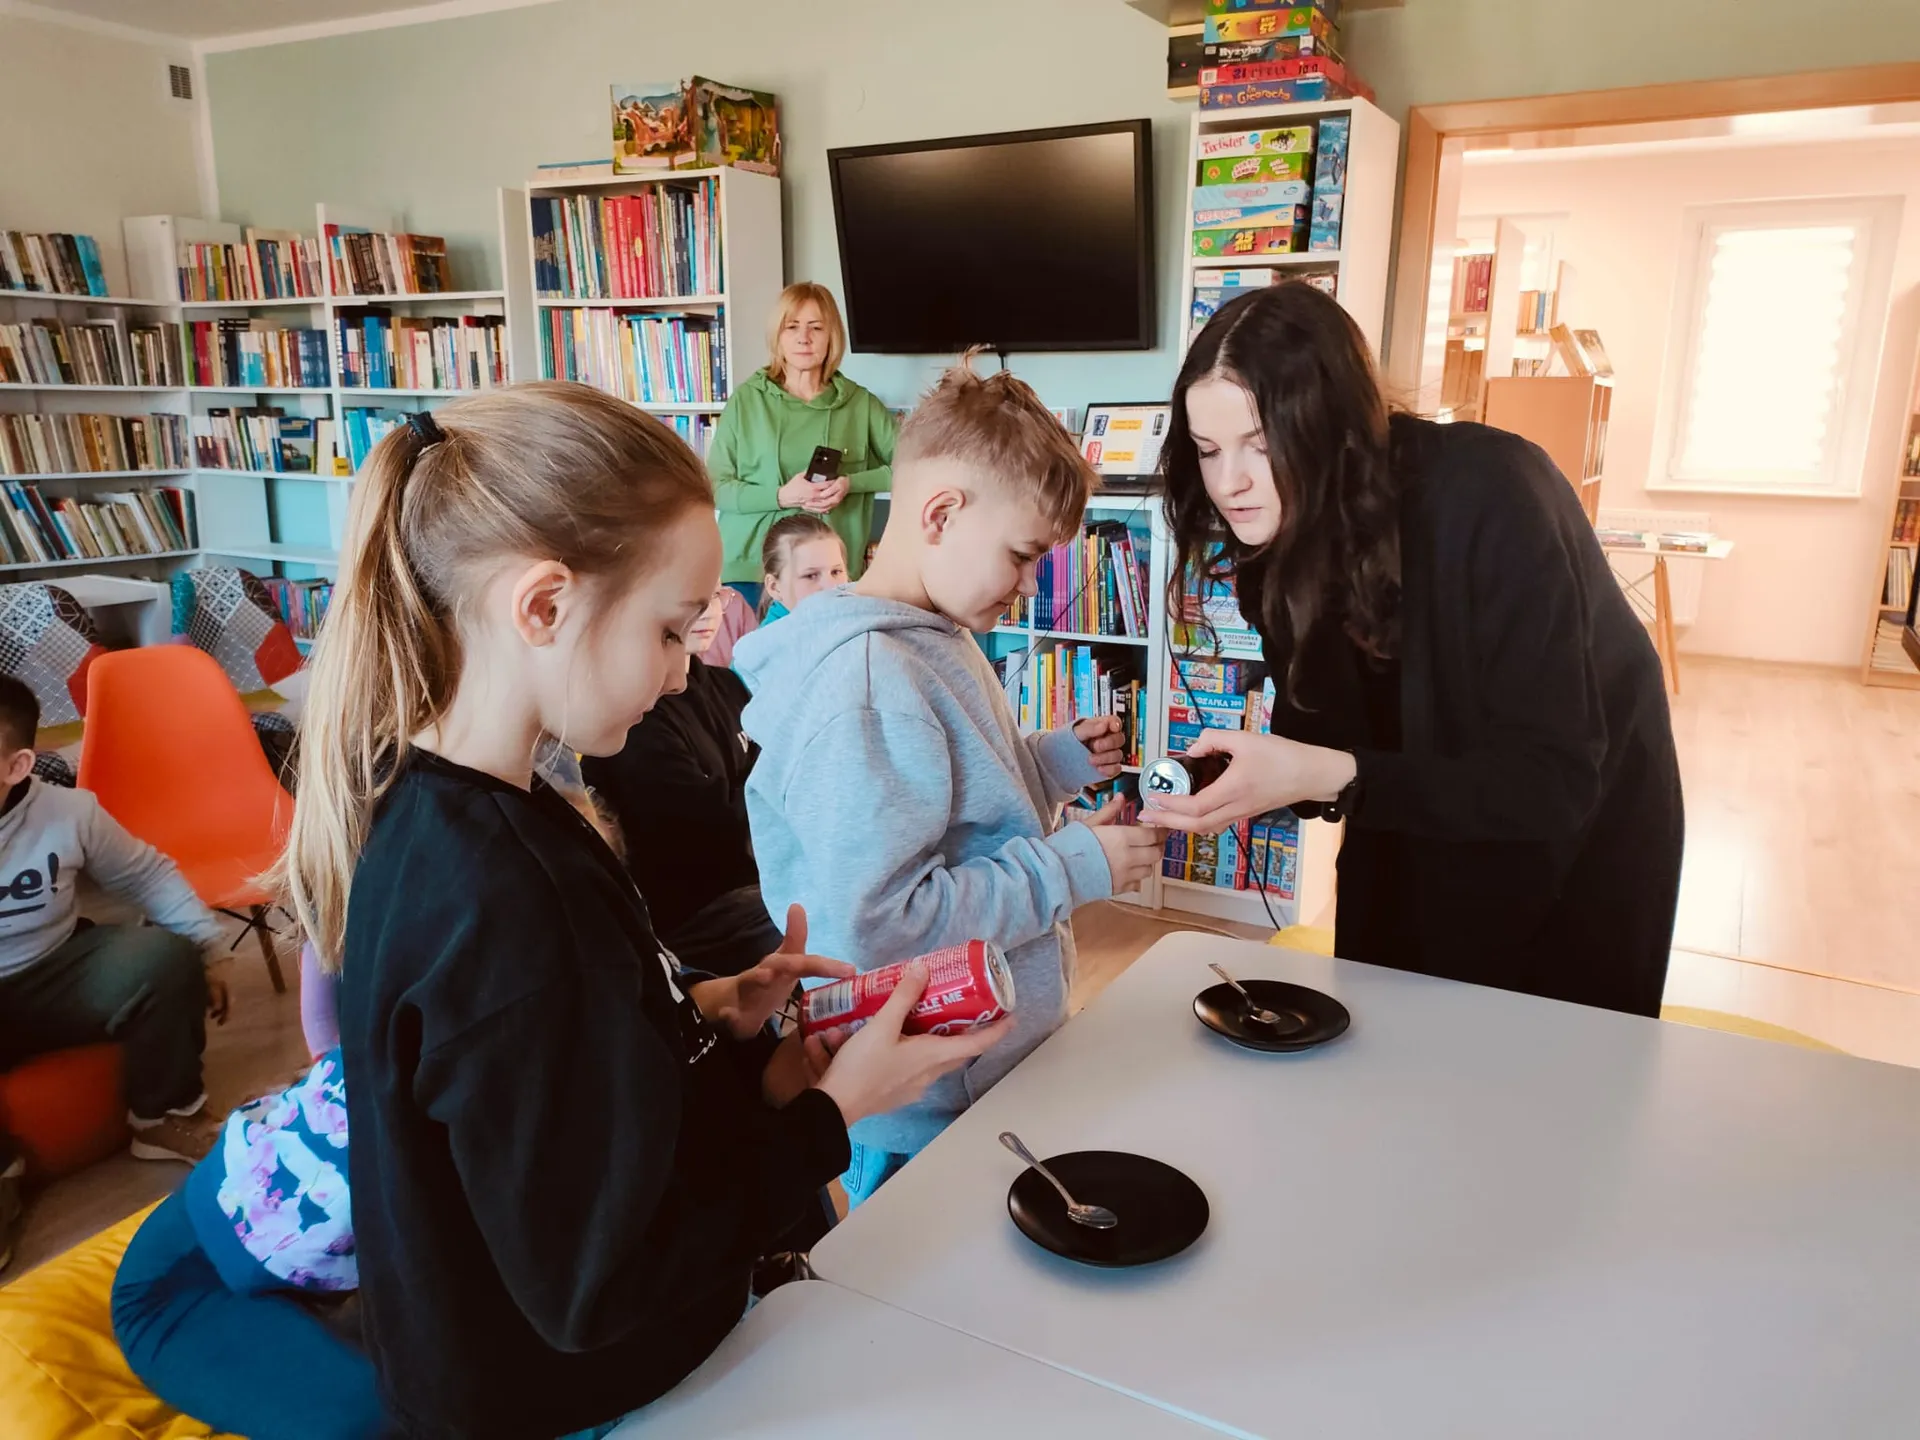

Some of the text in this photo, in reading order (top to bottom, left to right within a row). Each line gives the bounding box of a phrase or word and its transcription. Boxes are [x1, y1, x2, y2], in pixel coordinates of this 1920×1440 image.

[1219, 45, 1262, 58] Ryzyko
[1201, 135, 1245, 155] Twister
[944, 990, 965, 1004] ME
